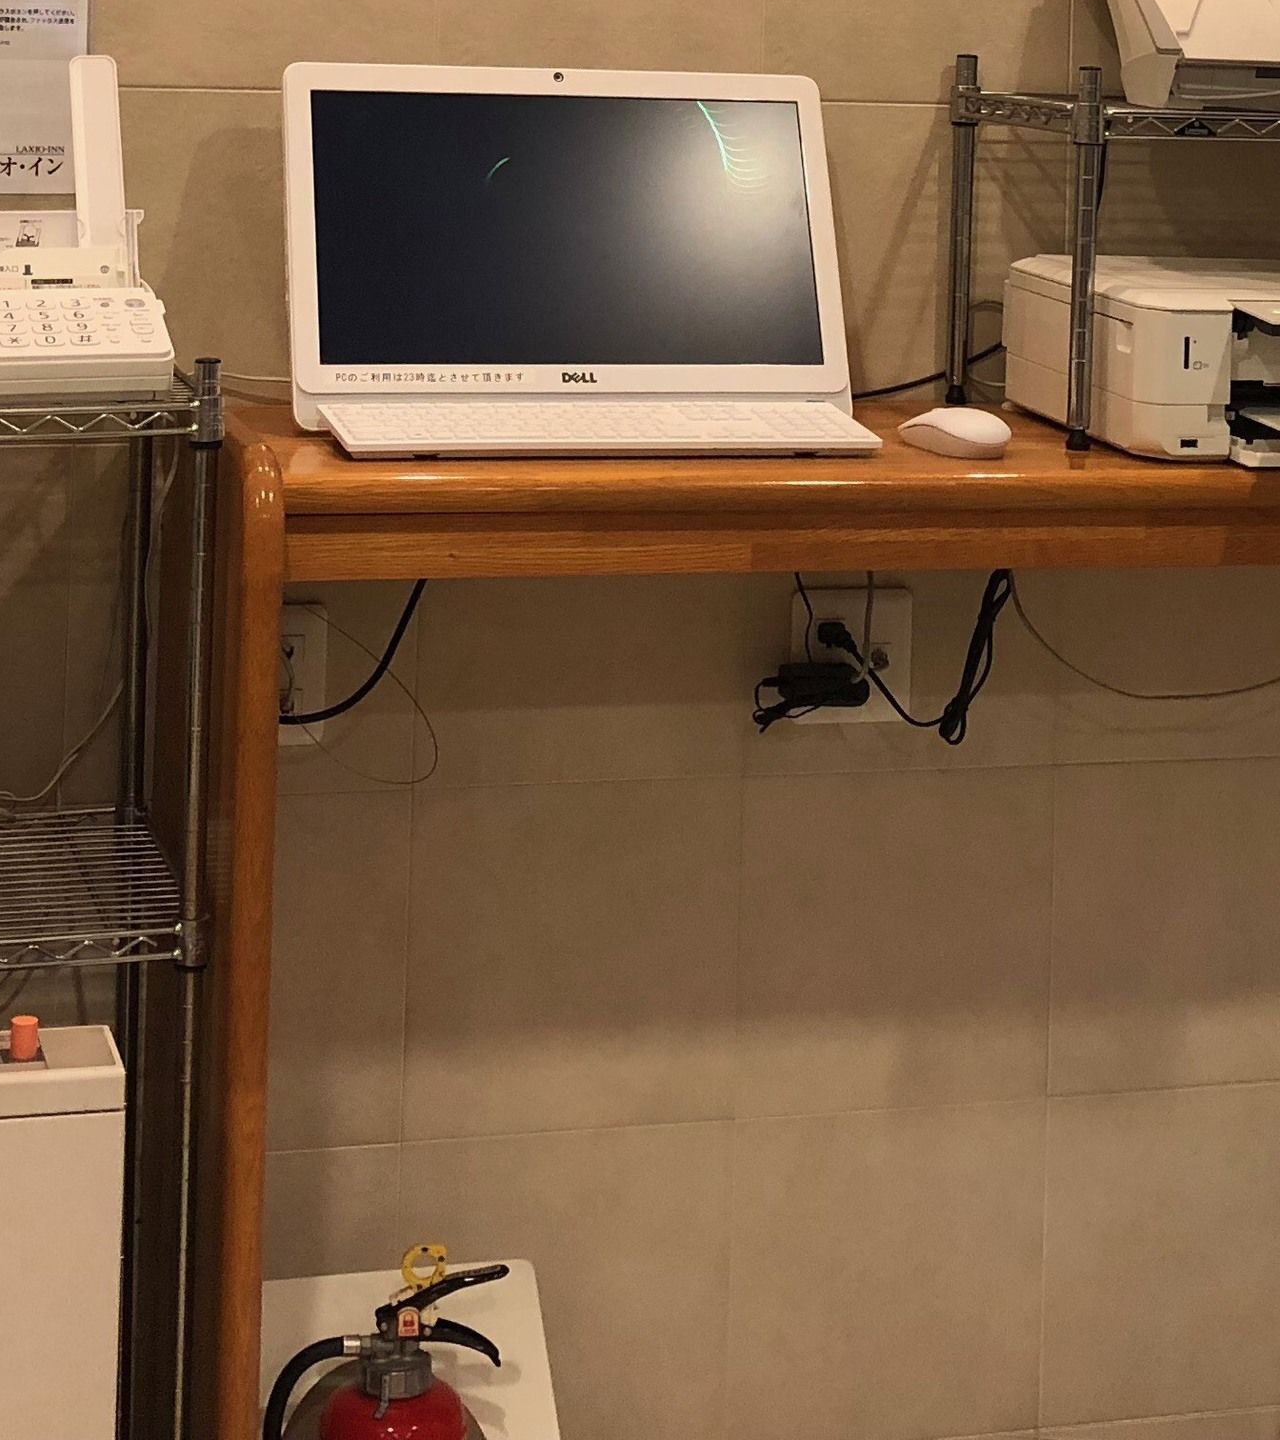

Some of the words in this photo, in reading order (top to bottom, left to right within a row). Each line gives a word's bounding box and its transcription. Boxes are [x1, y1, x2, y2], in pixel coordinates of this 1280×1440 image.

[3, 300, 10, 308] 1
[71, 299, 81, 307] 3
[9, 324, 17, 332] 7
[44, 336, 56, 344] 0
[561, 372, 598, 384] DELL
